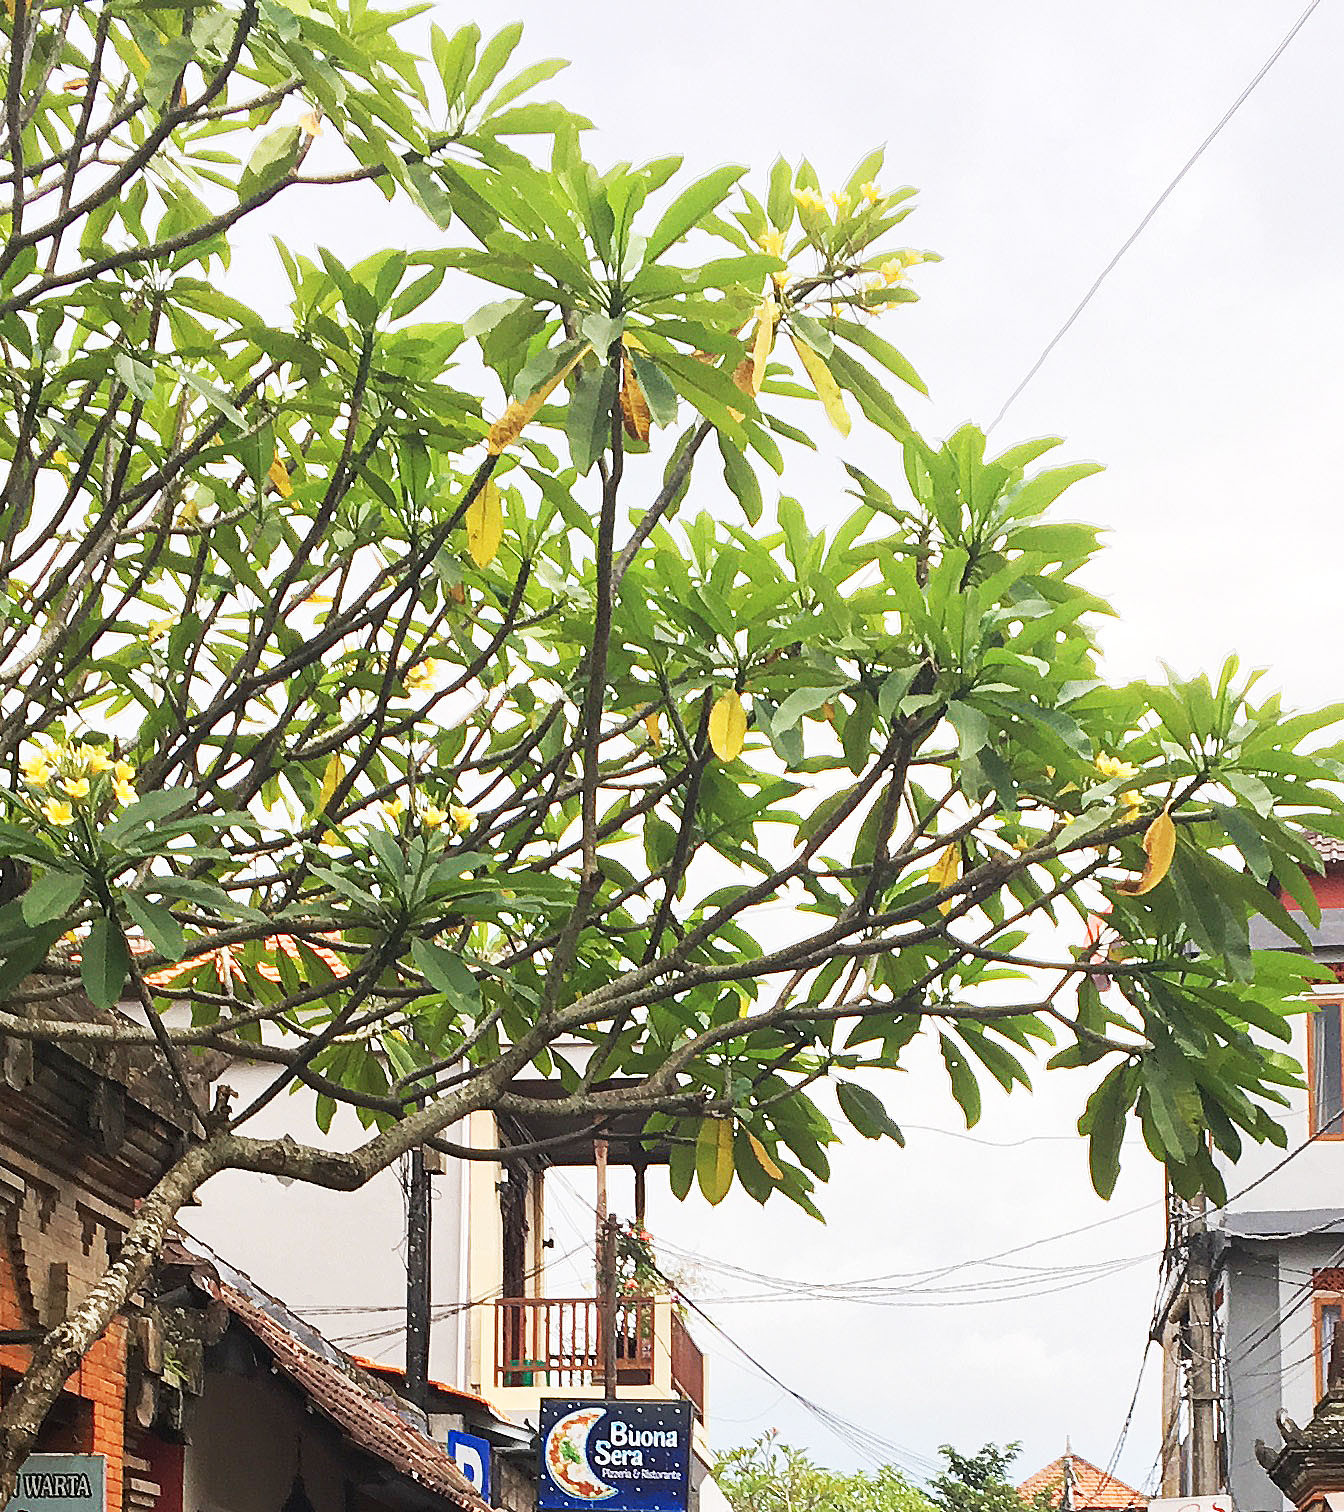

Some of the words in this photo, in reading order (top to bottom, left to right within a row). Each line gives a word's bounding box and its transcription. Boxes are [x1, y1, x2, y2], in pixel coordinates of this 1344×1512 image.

[611, 1421, 678, 1448] Buona
[594, 1440, 644, 1467] Sera
[25, 1473, 92, 1499] WARTA
